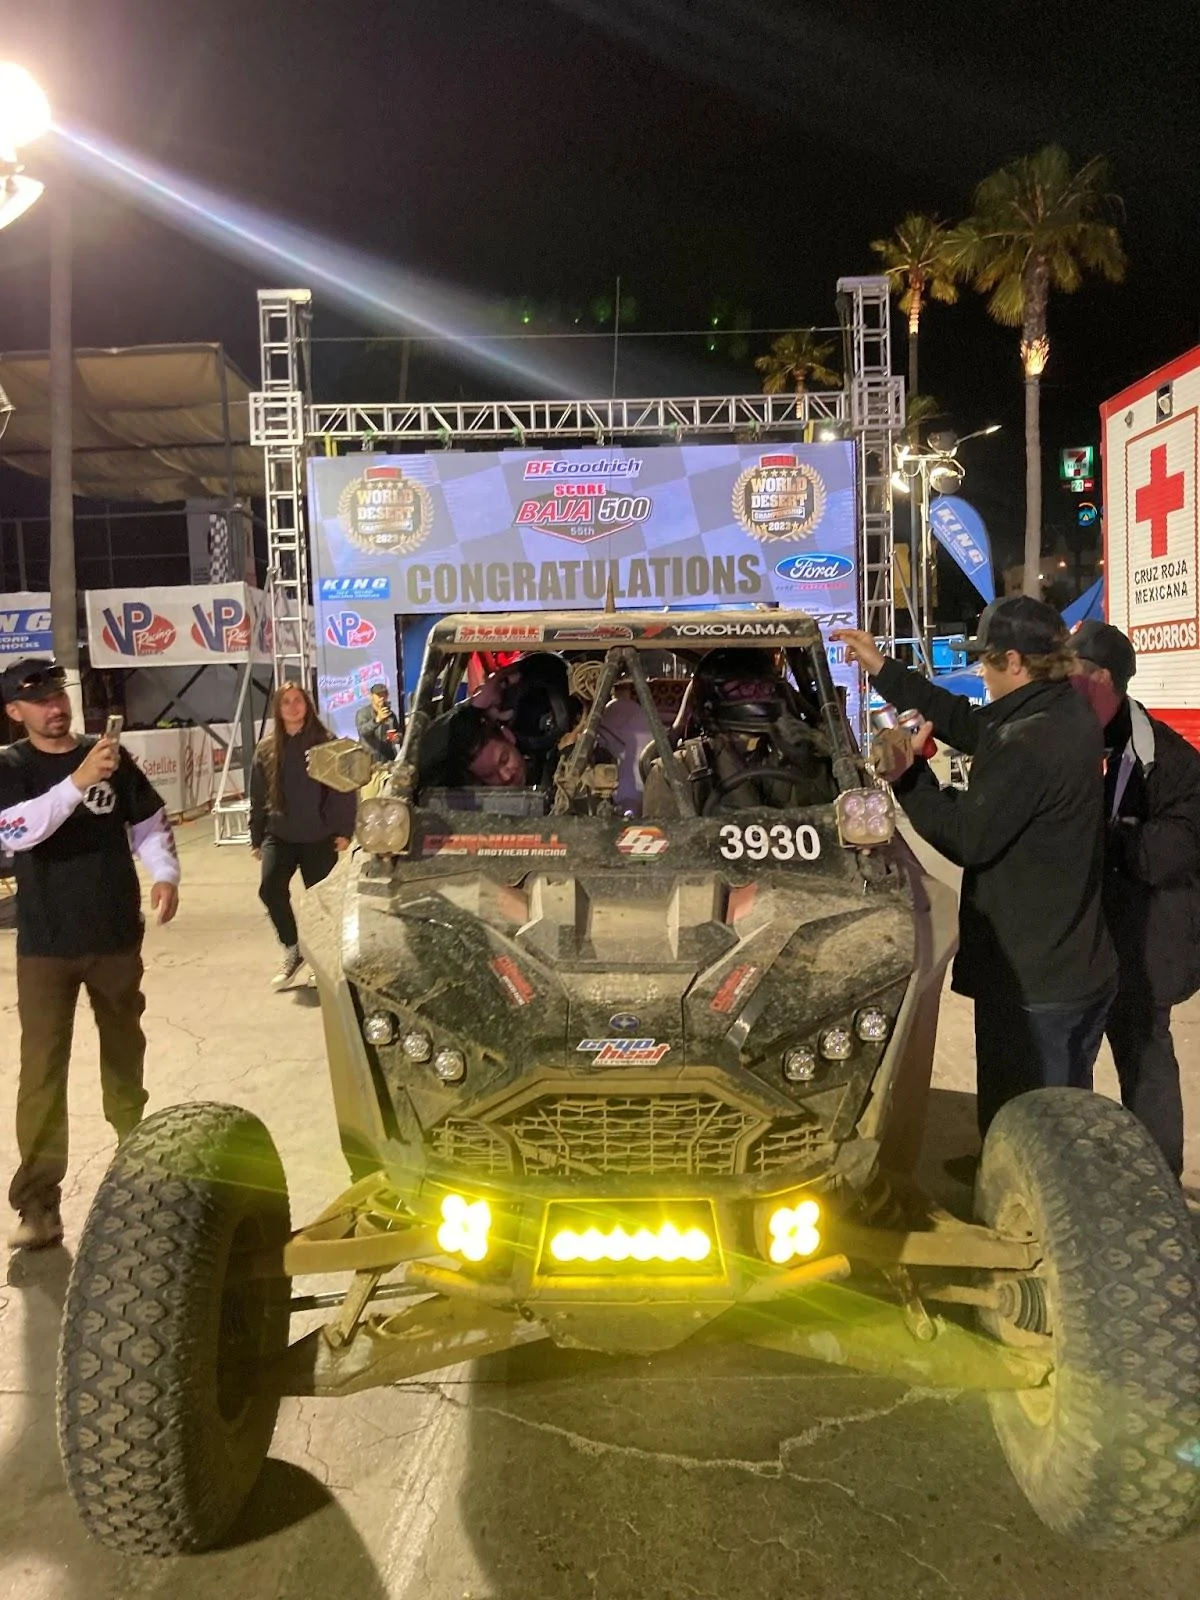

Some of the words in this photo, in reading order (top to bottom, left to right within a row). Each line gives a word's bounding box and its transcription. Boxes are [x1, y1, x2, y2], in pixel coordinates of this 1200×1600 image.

[526, 459, 641, 475] BFGoodrich
[555, 483, 606, 497] SCORE
[751, 477, 807, 492] WORLD
[356, 488, 414, 505] WORLD
[751, 493, 807, 508] DESERT
[357, 505, 415, 521] DESERT
[516, 499, 593, 523] BAJA
[598, 497, 652, 522] 500
[790, 557, 840, 579] Ford
[1134, 565, 1159, 585] CRUZ
[1161, 559, 1188, 580] ROJA
[322, 578, 388, 590] KING
[406, 554, 762, 606] CONGRATULATIONS
[1135, 581, 1188, 605] MEXICANA
[102, 602, 153, 657] VP
[192, 599, 243, 653] VP
[327, 611, 360, 648] VP
[672, 624, 791, 637] YOKOHAMA
[1132, 621, 1197, 652] SOCORROS
[135, 627, 176, 648] Racing
[142, 757, 177, 776] Satellite
[720, 824, 821, 860] 3930
